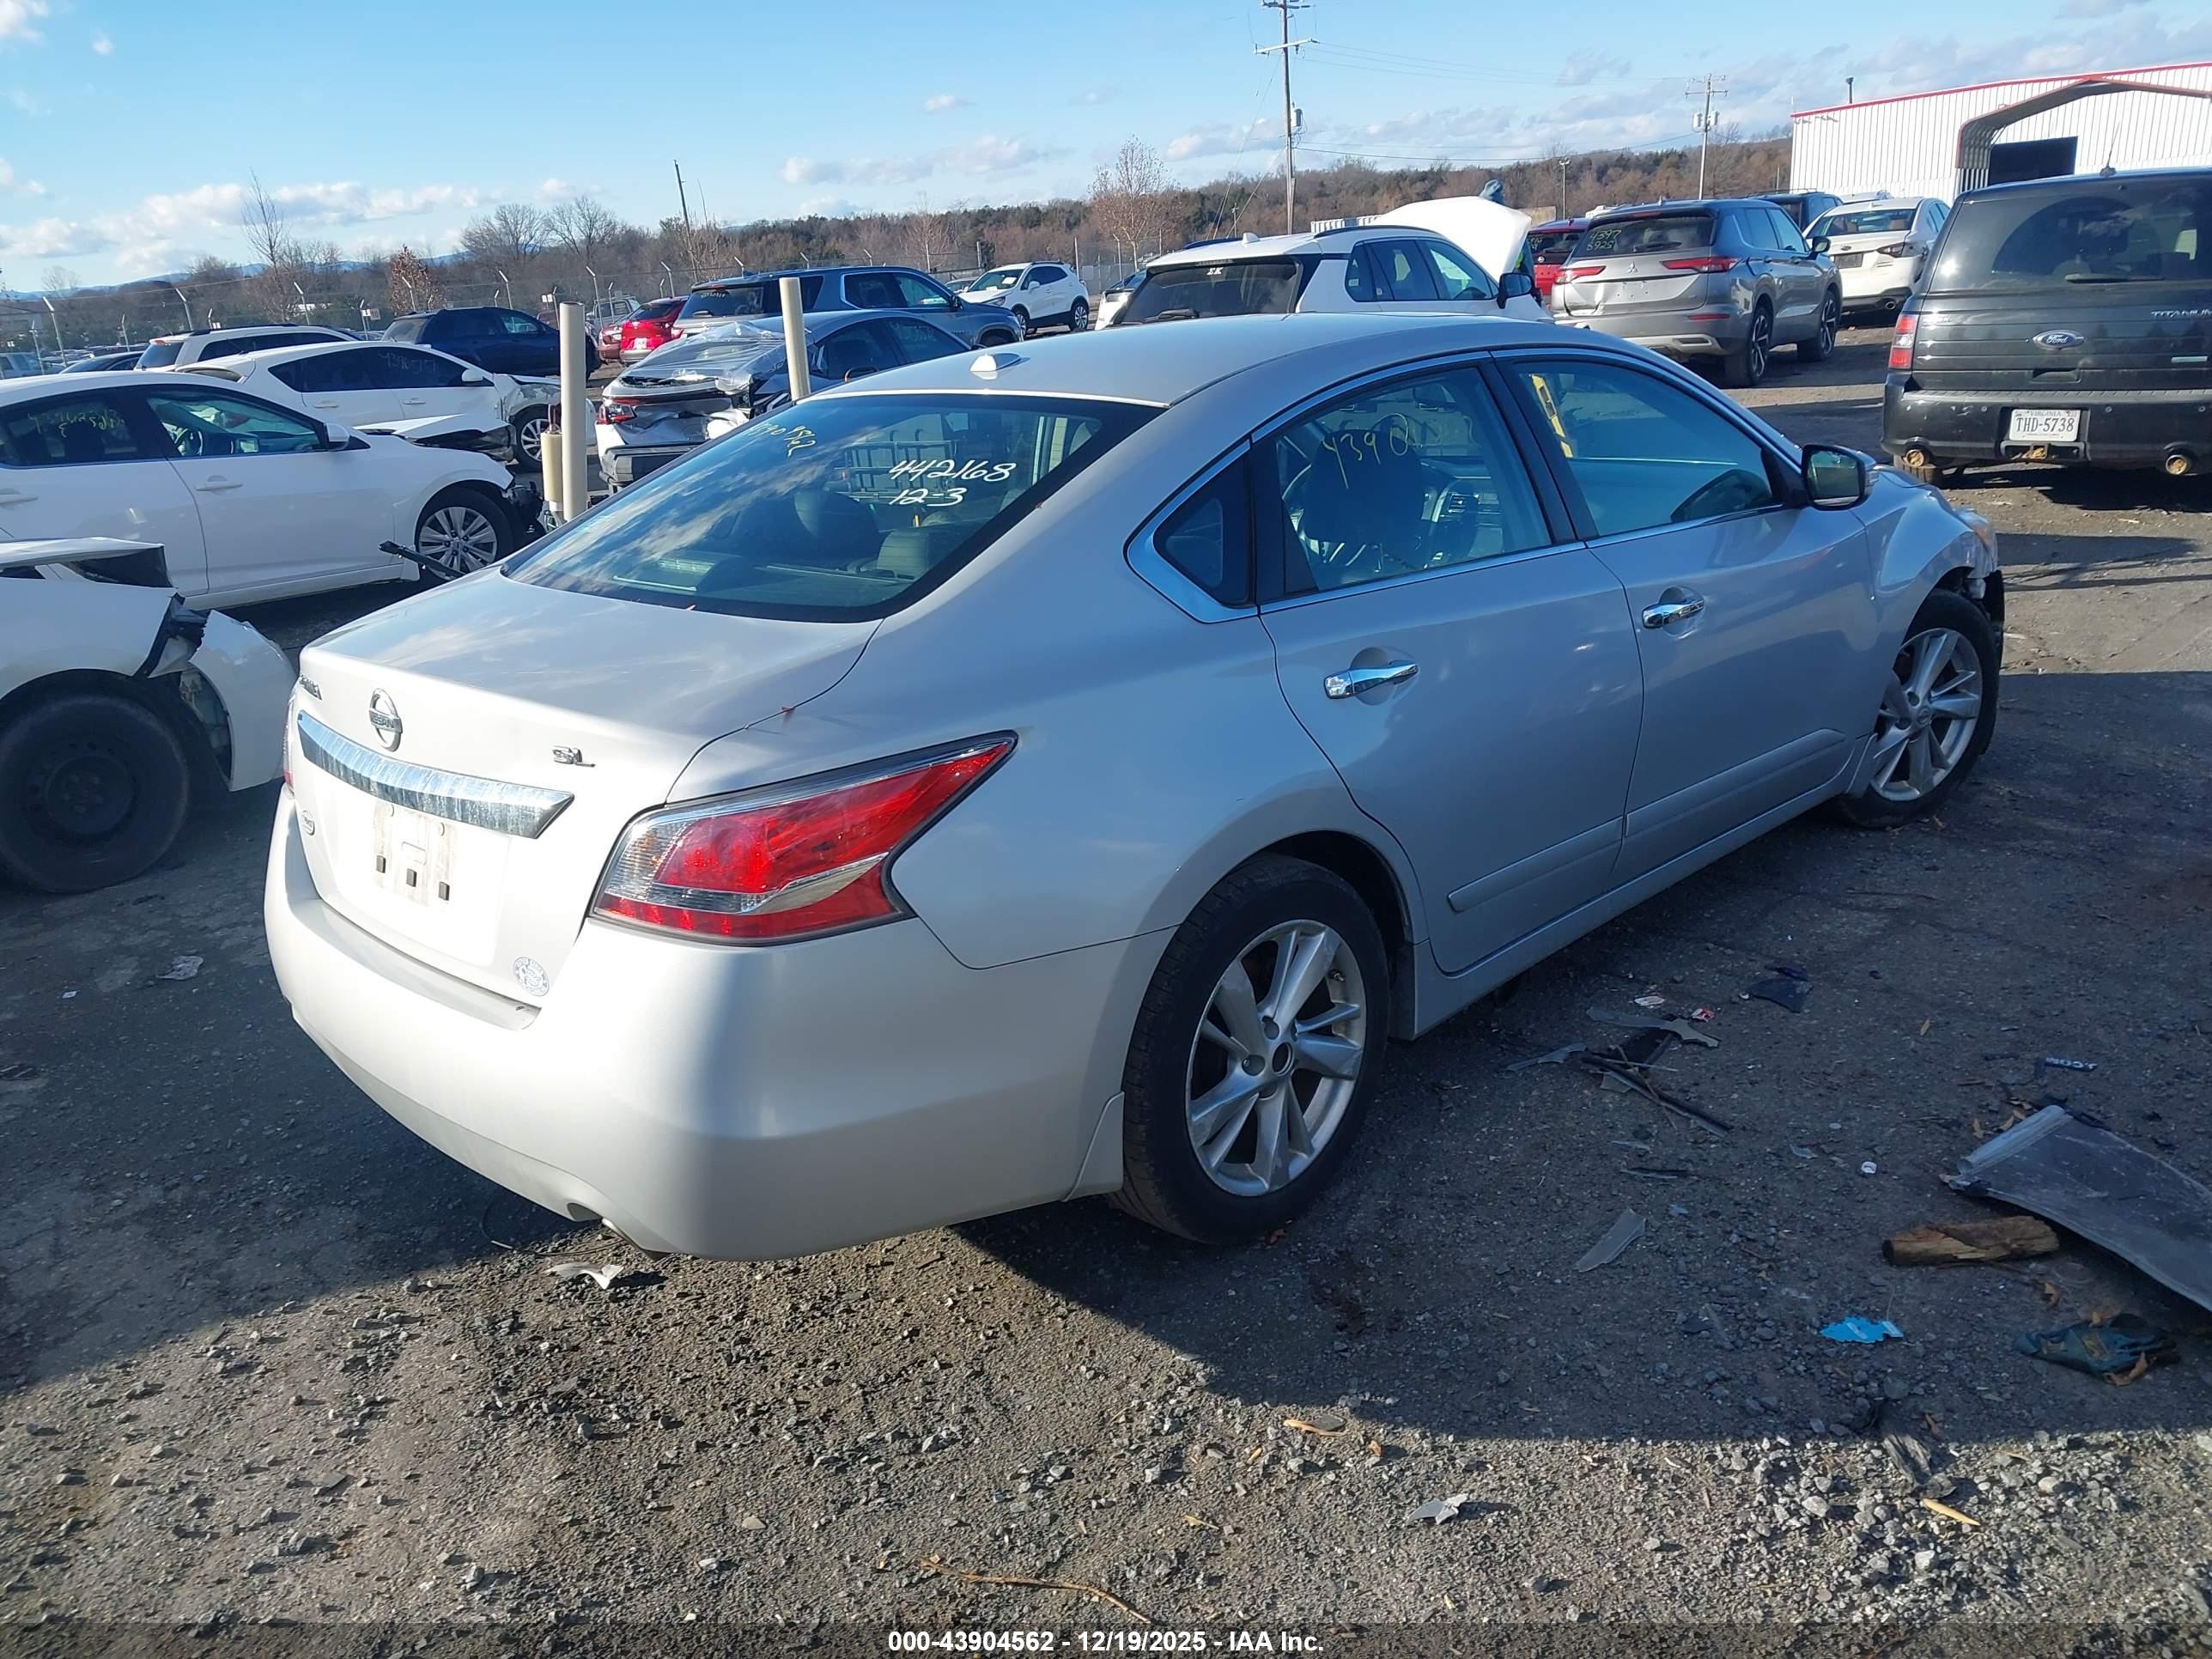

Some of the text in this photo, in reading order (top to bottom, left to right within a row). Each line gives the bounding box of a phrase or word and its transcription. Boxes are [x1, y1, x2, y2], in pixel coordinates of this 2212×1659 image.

[2015, 417, 2075, 432] THD-5738
[888, 459, 1018, 483] 442168
[888, 486, 968, 507] 12-3
